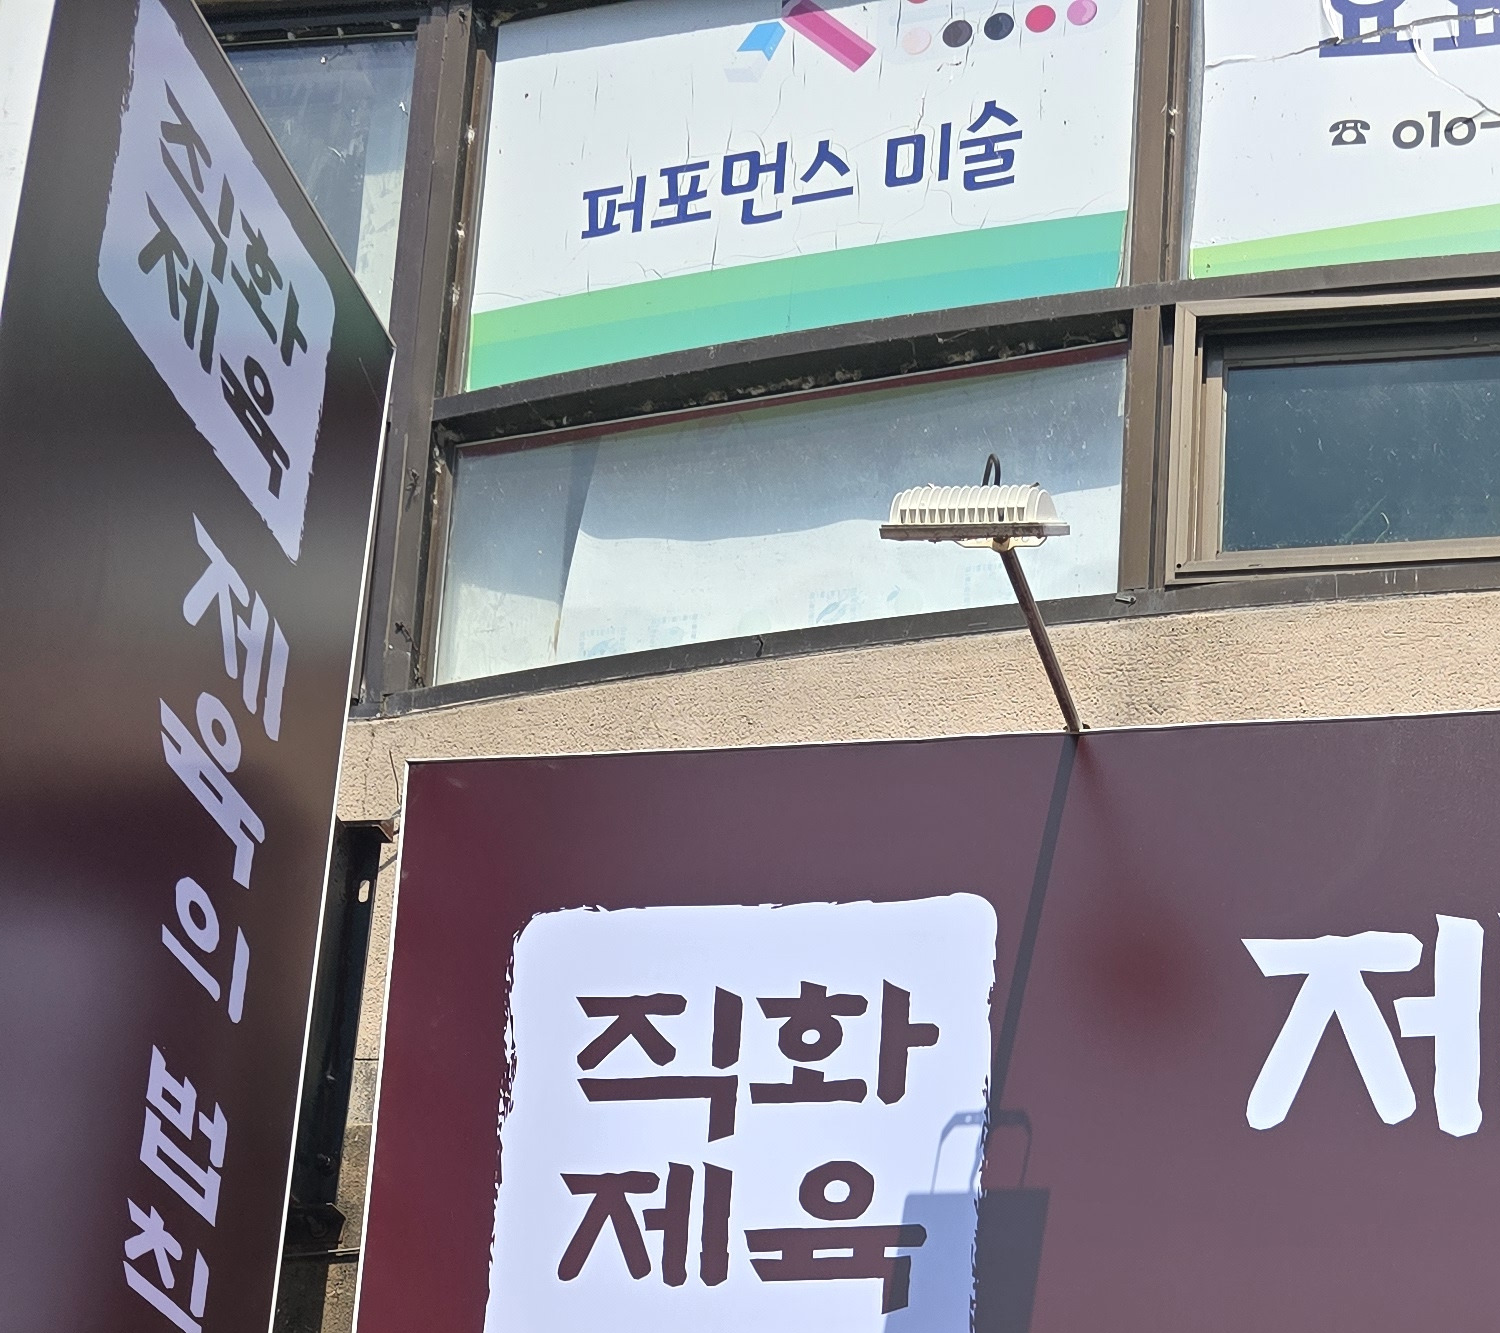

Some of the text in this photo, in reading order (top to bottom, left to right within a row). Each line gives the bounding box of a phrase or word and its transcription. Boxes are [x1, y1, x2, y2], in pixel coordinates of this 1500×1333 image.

[160, 79, 308, 367] 직화
[581, 99, 1024, 240] 퍼포먼스 미술
[137, 190, 291, 499] 제육
[160, 511, 290, 1024] 제육의
[576, 978, 940, 1143] 직화
[557, 1160, 928, 1315] 제육
